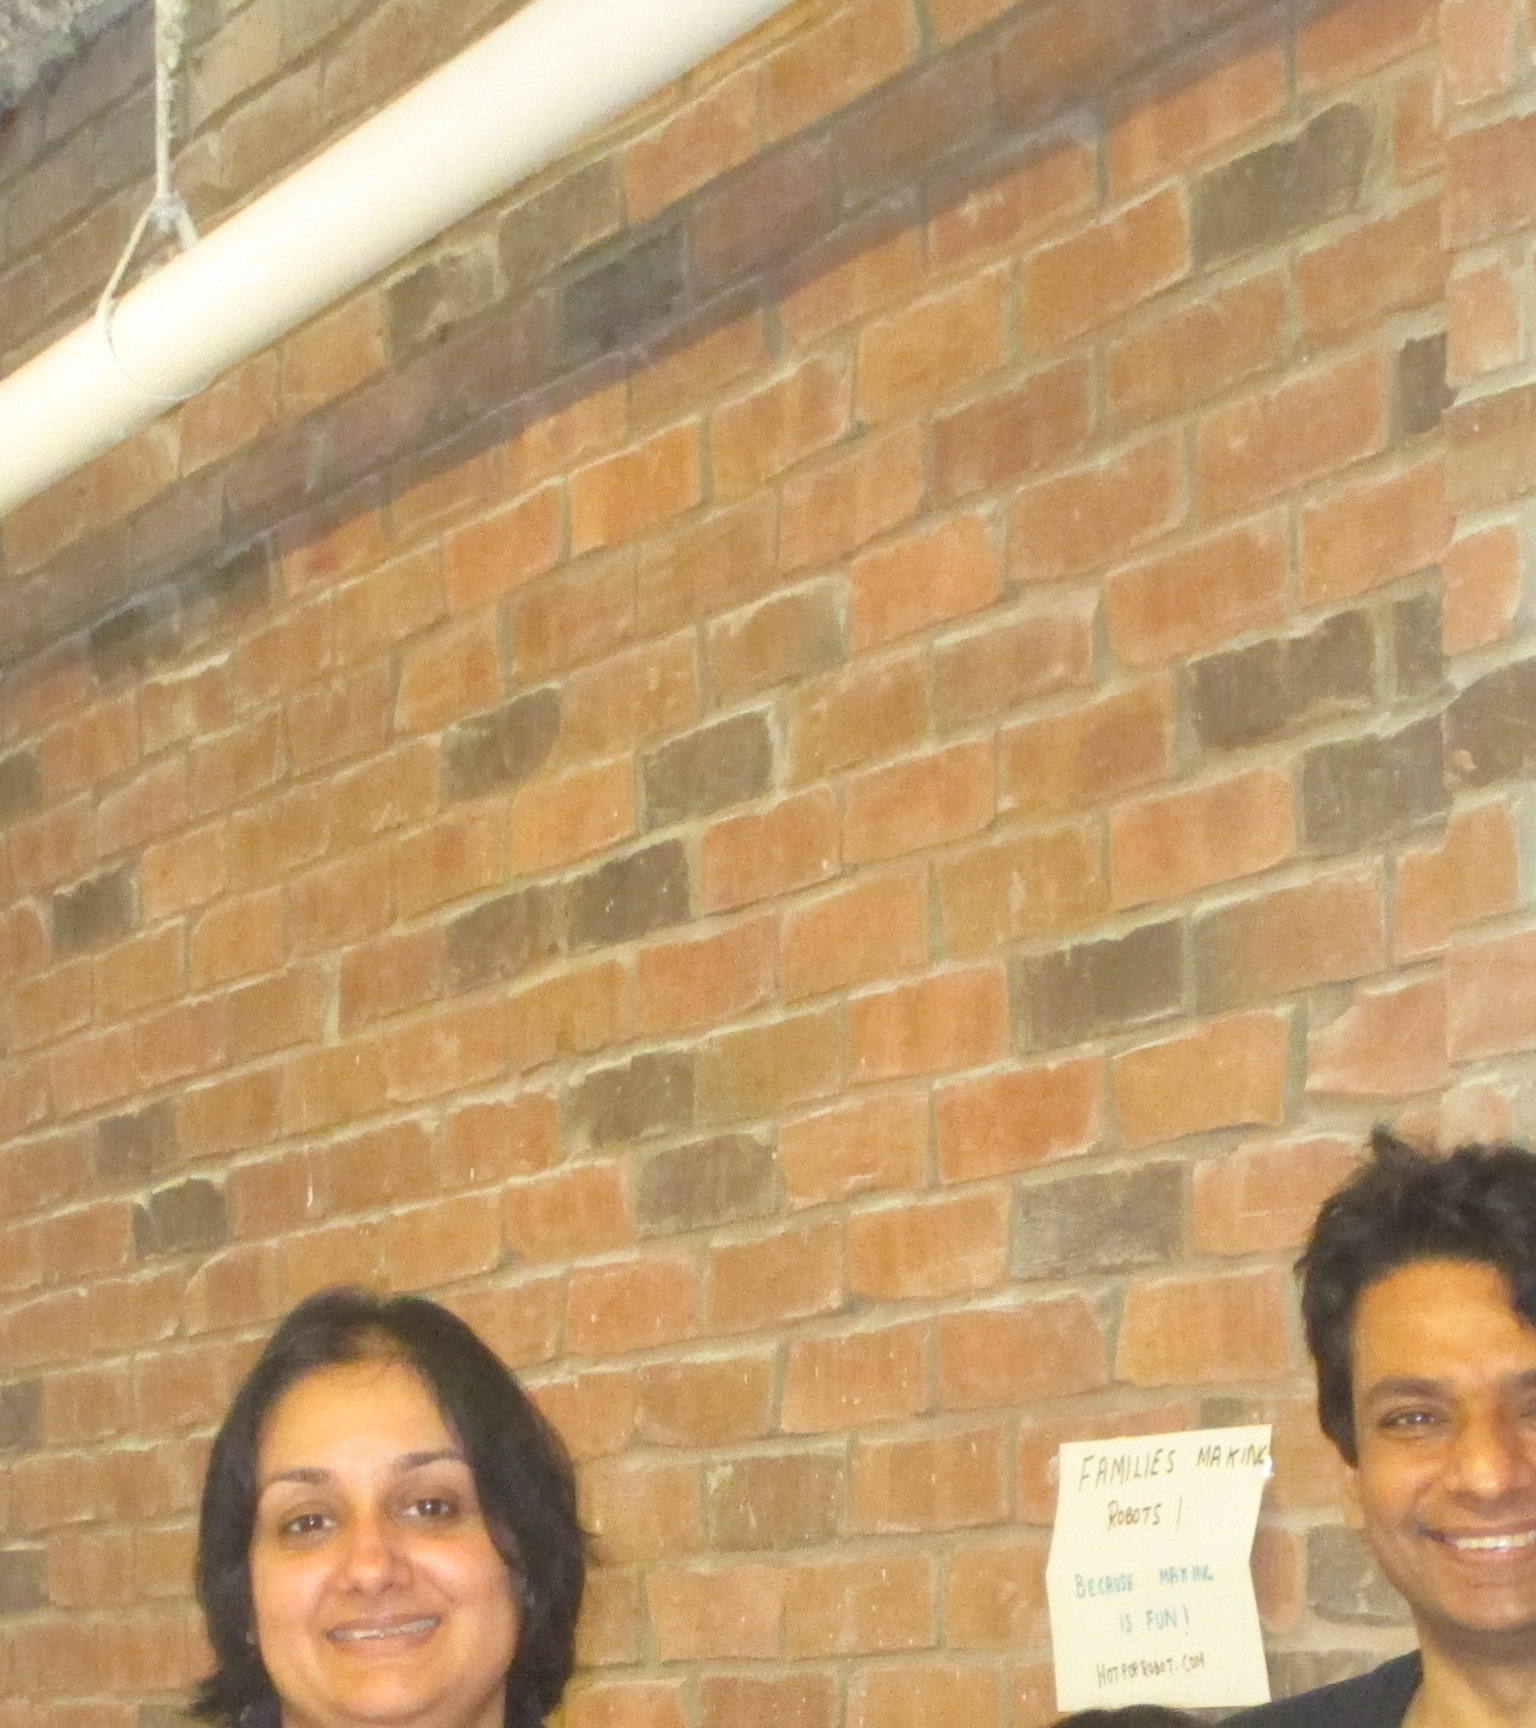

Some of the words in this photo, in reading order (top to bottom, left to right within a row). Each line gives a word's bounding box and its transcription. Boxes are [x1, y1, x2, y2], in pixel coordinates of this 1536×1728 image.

[1078, 1448, 1176, 1492] FAMILIES
[1075, 1573, 1134, 1599] BECAUSE
[1119, 1612, 1133, 1634] IS
